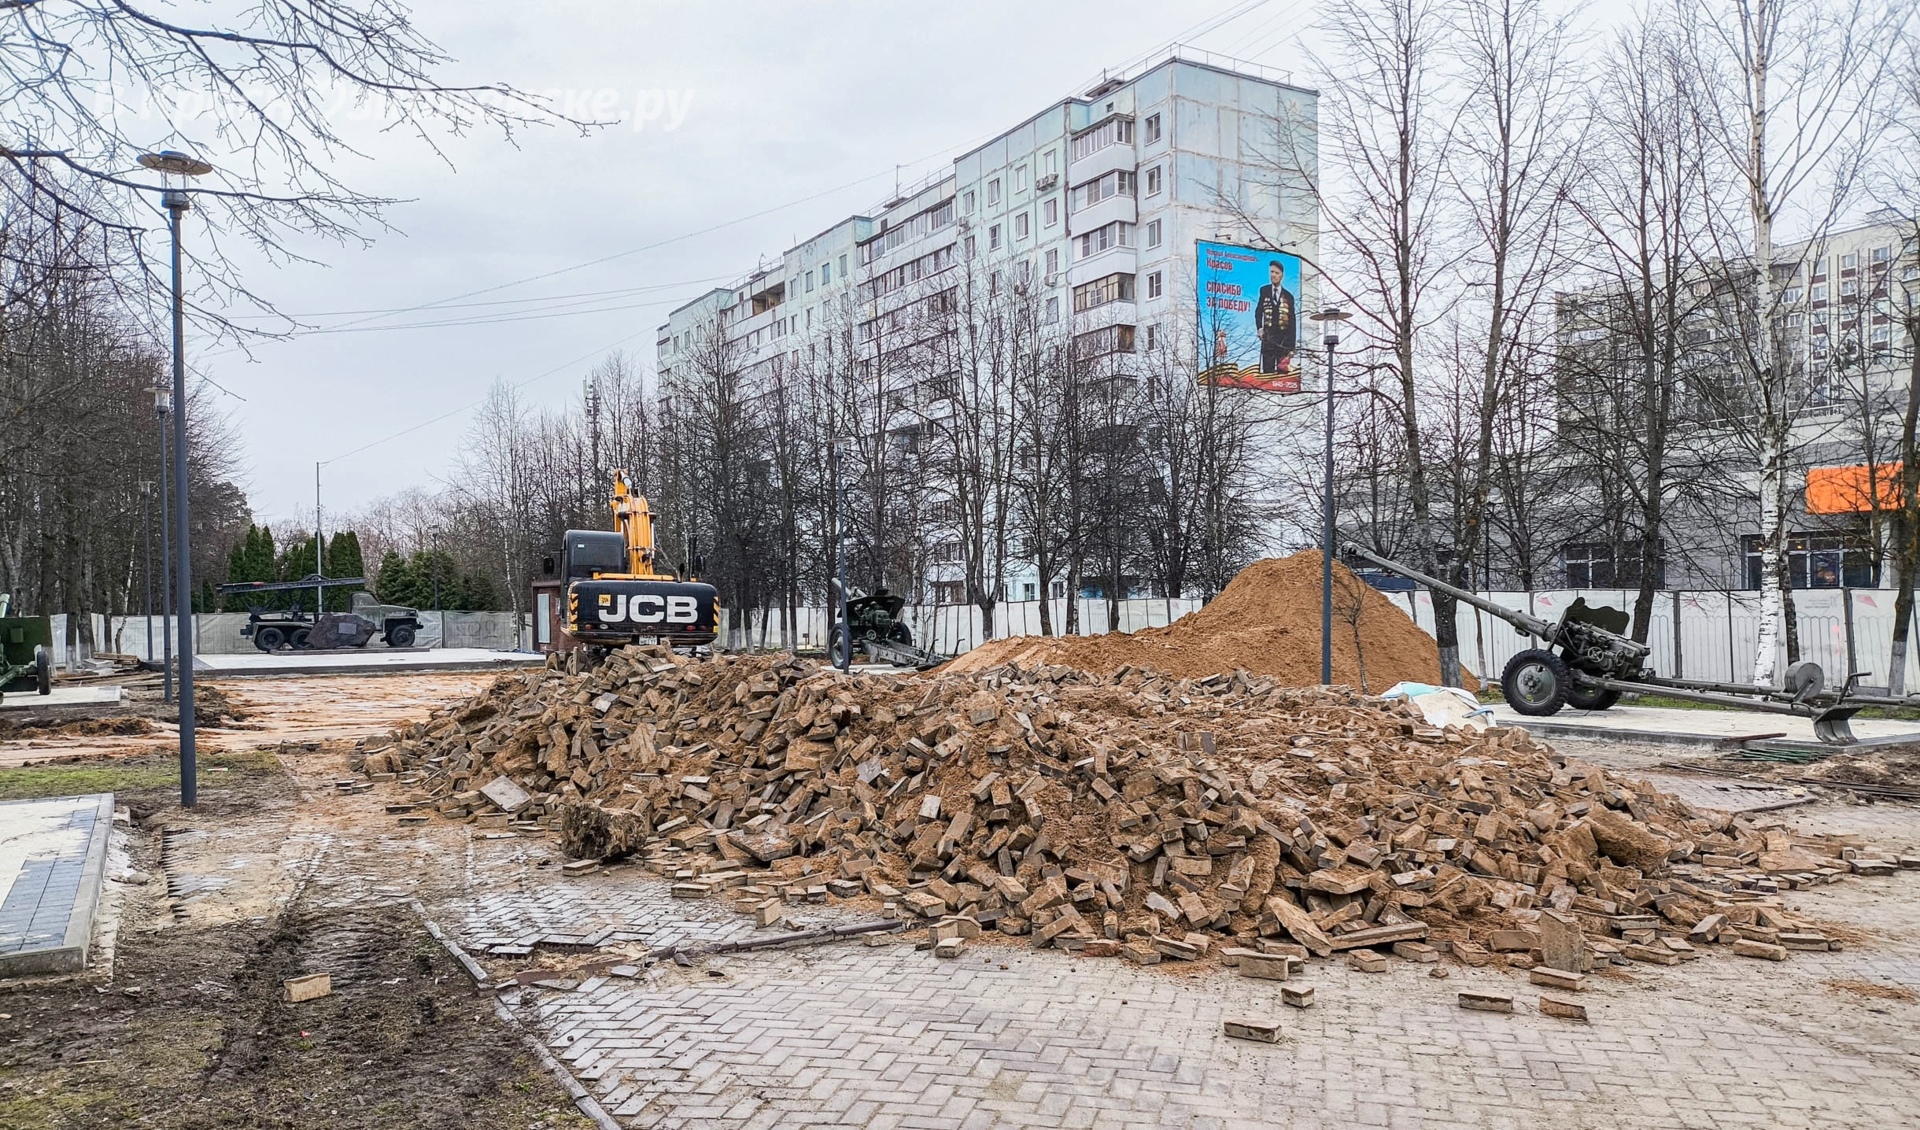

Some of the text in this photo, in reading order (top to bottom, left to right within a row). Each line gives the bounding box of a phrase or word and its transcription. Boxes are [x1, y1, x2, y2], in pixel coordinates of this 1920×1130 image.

[1206, 257, 1233, 271] Красов
[1206, 280, 1242, 296] СПАСИБО
[1206, 296, 1251, 313] ЗА ПОБЕДУ!
[598, 594, 698, 623] JCB
